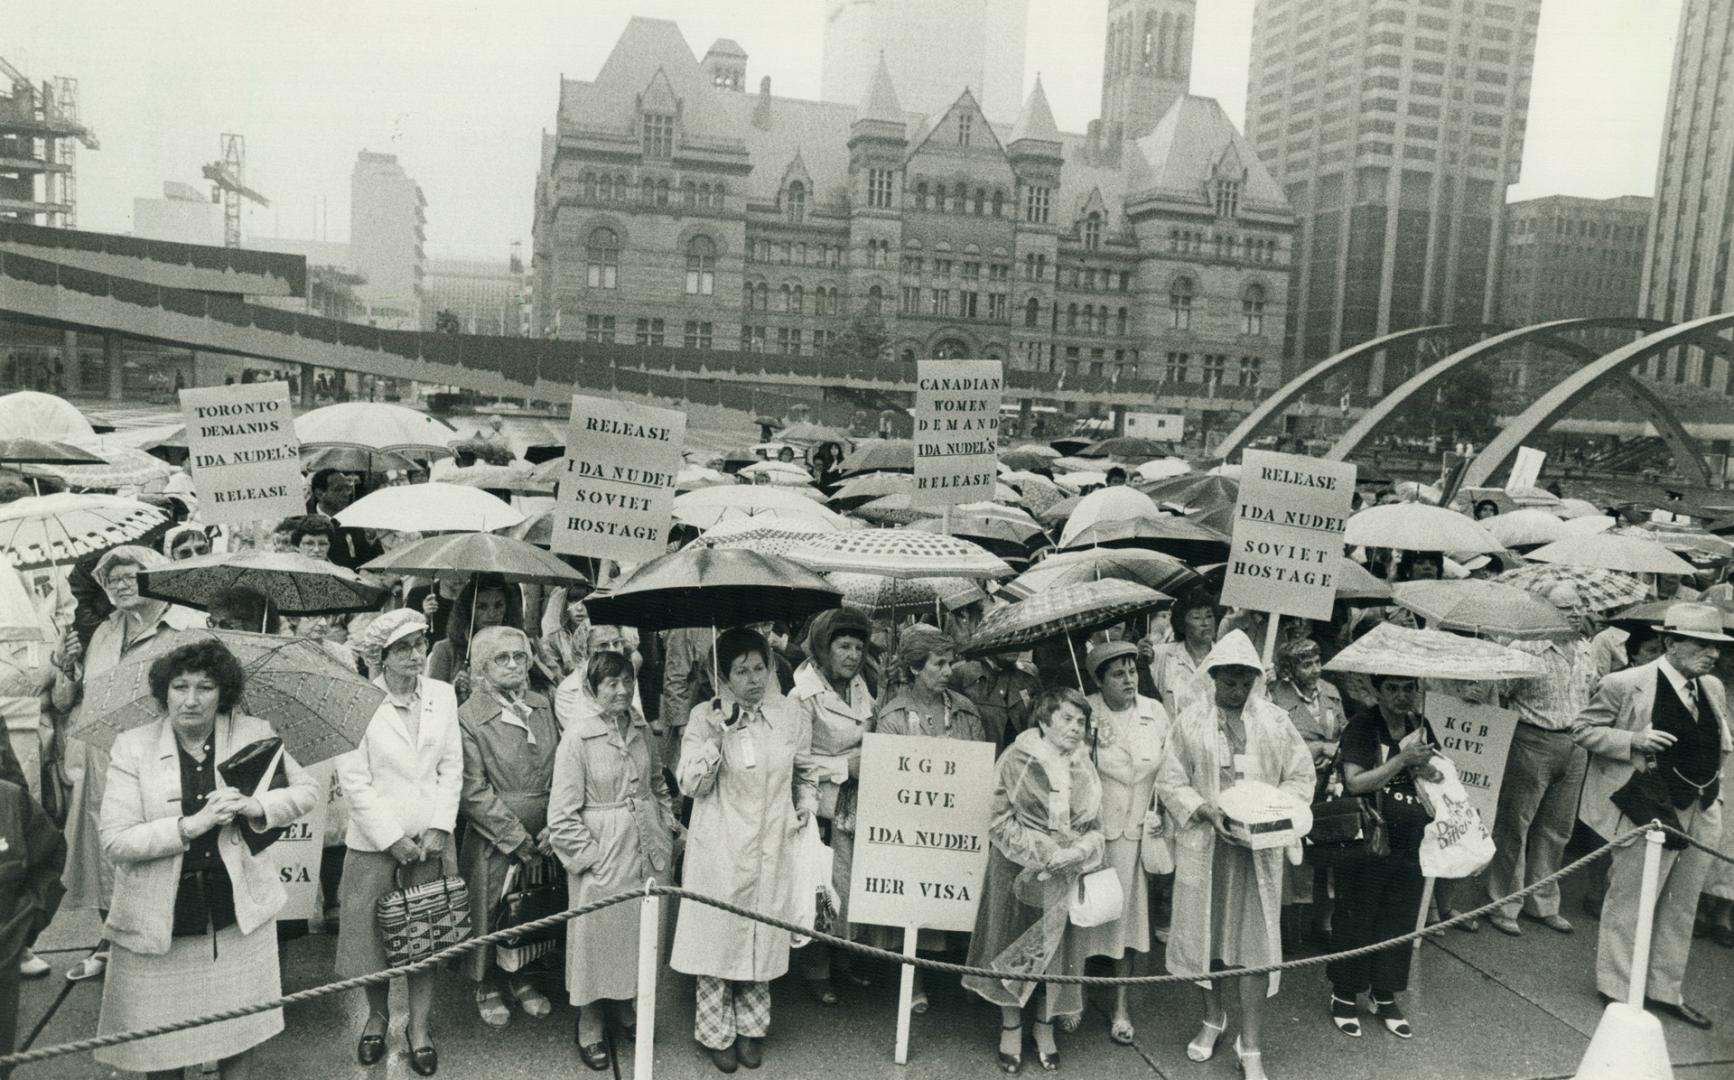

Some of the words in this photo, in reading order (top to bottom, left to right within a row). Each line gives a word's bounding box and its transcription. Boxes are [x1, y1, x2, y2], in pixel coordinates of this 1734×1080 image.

[920, 378, 1000, 391] CANADIAN
[195, 400, 279, 418] TORONTO
[934, 400, 987, 412] WOMEN
[201, 420, 279, 437] DEMANDS
[586, 417, 670, 442] RELEASE
[919, 418, 998, 431] DEMAND
[195, 454, 226, 467] IDA
[233, 444, 298, 463] NUDEL'S
[918, 444, 941, 456] IDA
[947, 437, 995, 455] NUDEL'S
[567, 459, 604, 477] IDA
[612, 466, 676, 488] NUDEL
[918, 474, 991, 489] RELEASE
[1261, 466, 1337, 490] RELEASE
[214, 485, 288, 503] RELEASE
[575, 489, 652, 511] SOVIET
[567, 516, 658, 541] HOSTAGE
[1240, 504, 1275, 522] IDA
[1284, 511, 1346, 532] NUDEL
[1244, 540, 1328, 563] SOVIET
[1233, 561, 1332, 588] HOSTAGE
[1443, 736, 1484, 755] GIVE
[897, 788, 955, 809] GIVE
[868, 826, 904, 844] IDA
[915, 830, 982, 851] NUDEL
[865, 877, 904, 896] HER
[919, 882, 970, 901] VISA
